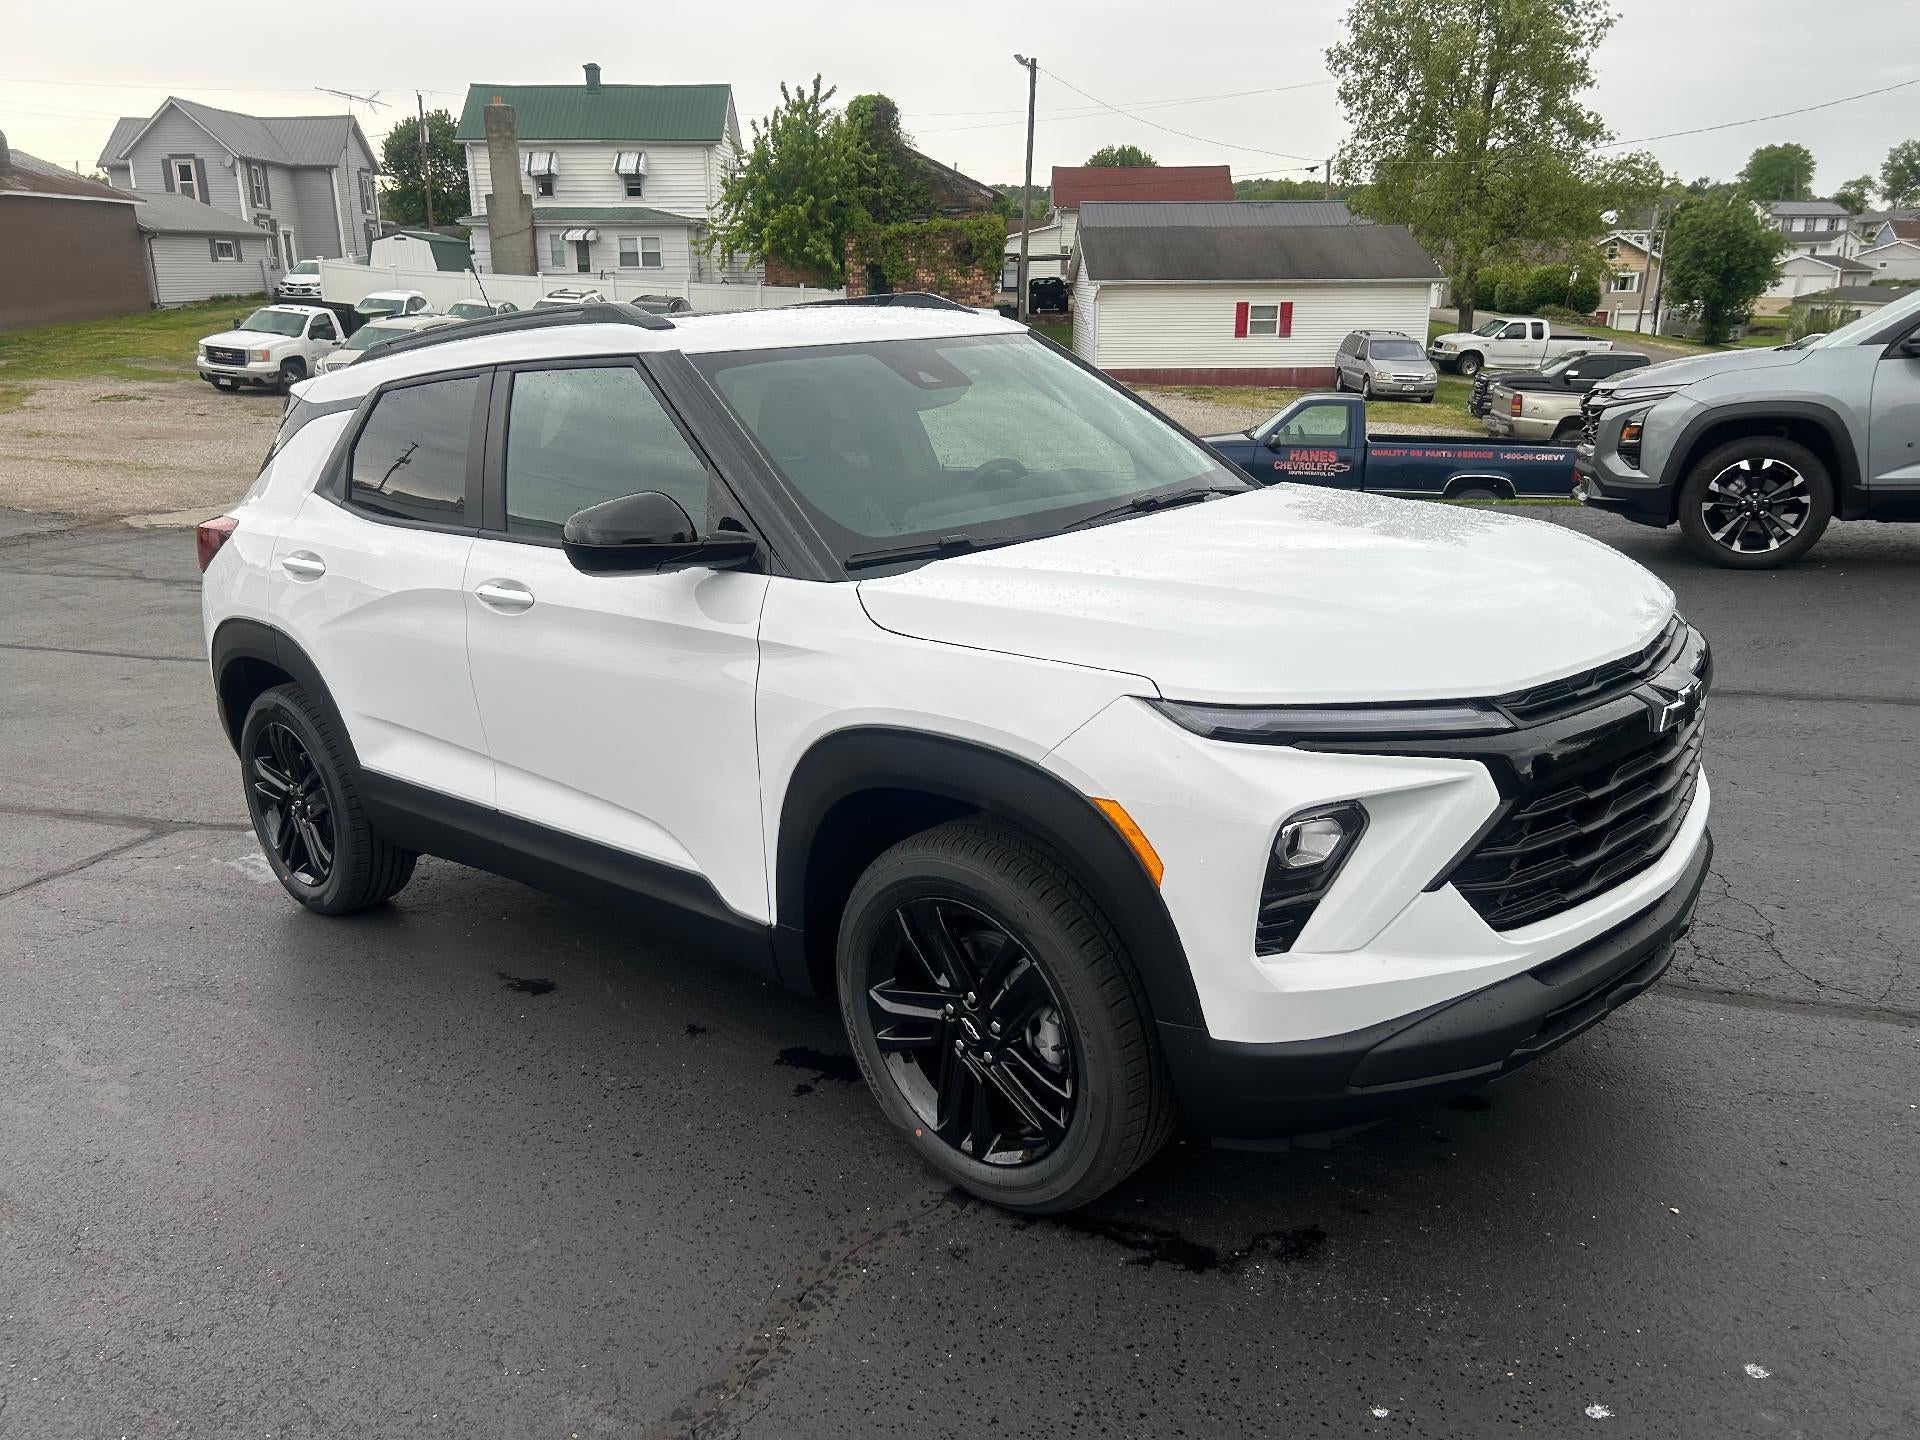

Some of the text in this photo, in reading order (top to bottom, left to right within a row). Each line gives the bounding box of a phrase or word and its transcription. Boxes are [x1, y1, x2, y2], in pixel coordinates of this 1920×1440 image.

[1289, 449, 1337, 463] HANES
[1371, 449, 1407, 457] QUALITY
[1274, 461, 1329, 471] CHEVROLET
